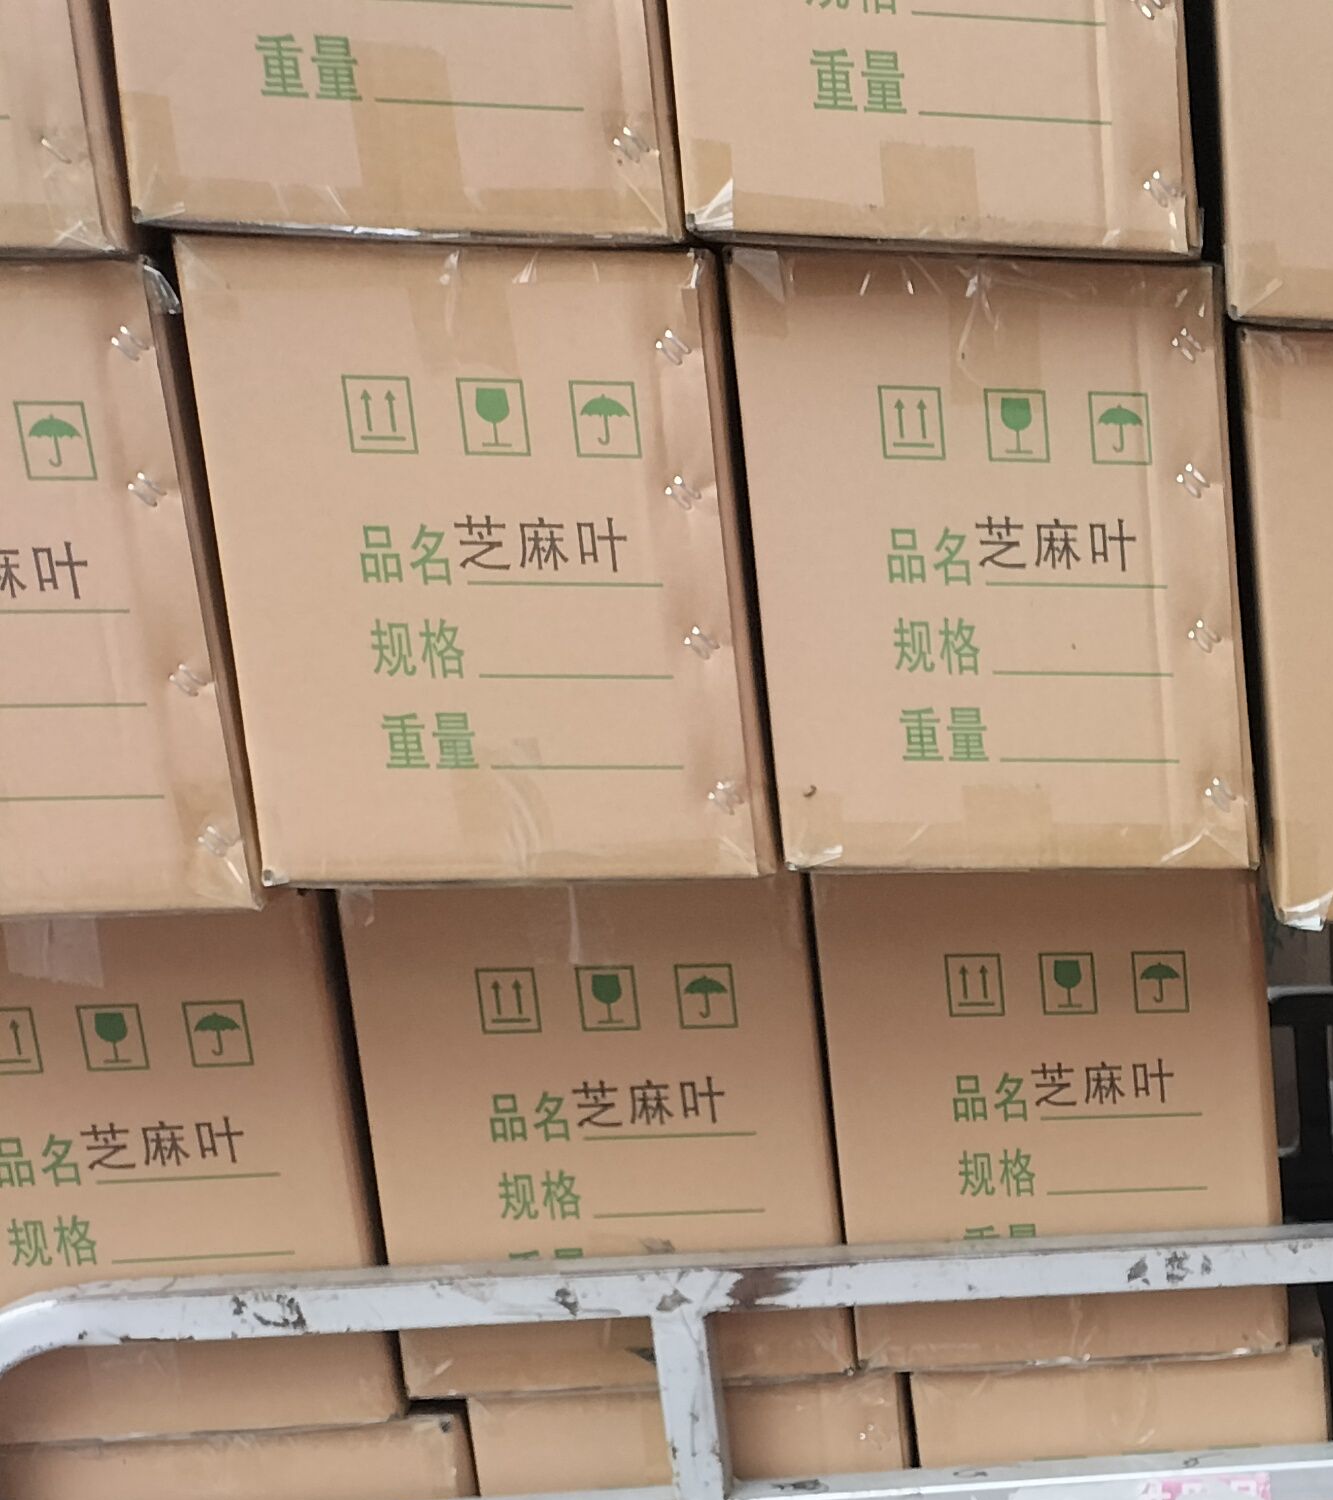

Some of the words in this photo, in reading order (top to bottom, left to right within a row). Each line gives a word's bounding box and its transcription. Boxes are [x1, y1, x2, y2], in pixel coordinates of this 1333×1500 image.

[255, 34, 363, 101] 重量
[809, 48, 908, 115] 重量
[359, 514, 628, 586] 品名芝麻叶
[886, 515, 1137, 587] 品名芝麻叶
[370, 618, 466, 680] 规格
[893, 617, 982, 676] 规格
[381, 711, 480, 770] 重量
[900, 707, 990, 764] 重量
[489, 1076, 726, 1144] 品名芝麻叶
[952, 1057, 1175, 1122] 品名芝麻叶
[0, 1116, 244, 1188] 品名芝麻叶
[958, 1146, 1036, 1199] 规格
[498, 1169, 582, 1222] 规格
[8, 1215, 99, 1269] 规格
